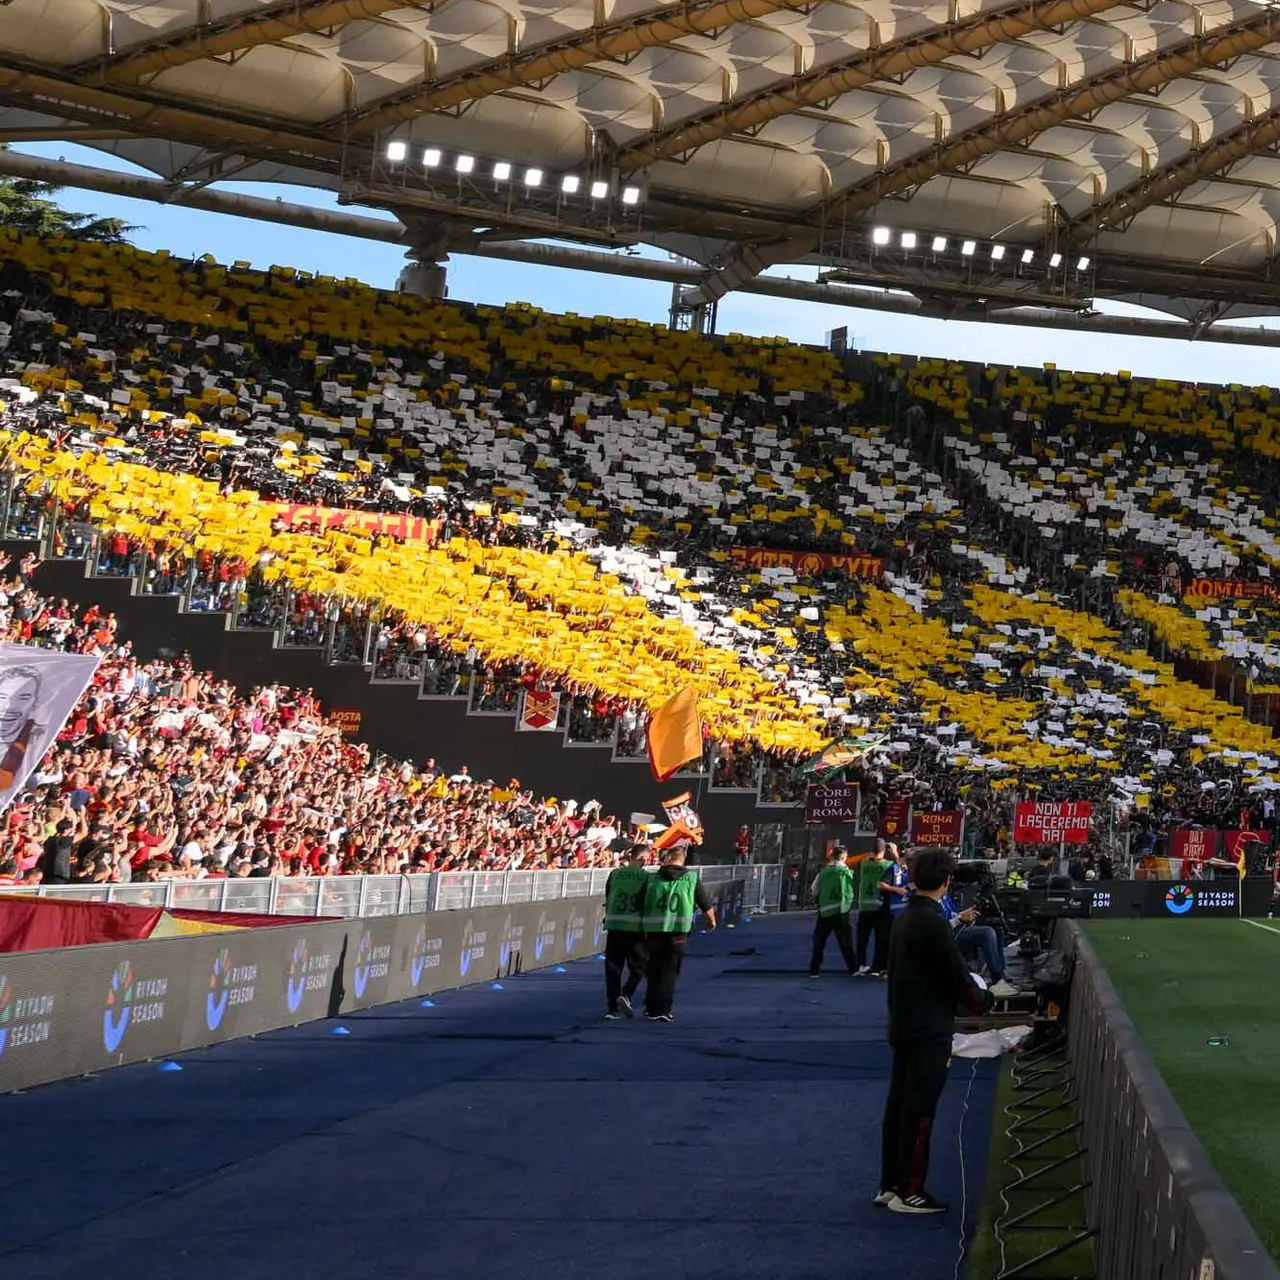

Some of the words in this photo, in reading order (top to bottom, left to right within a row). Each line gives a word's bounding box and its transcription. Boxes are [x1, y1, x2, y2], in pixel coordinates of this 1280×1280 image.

[814, 789, 852, 798] CORE
[824, 799, 842, 807] DE
[1035, 803, 1060, 816] NON
[1067, 803, 1077, 816] TI
[812, 808, 853, 817] ROMA
[922, 815, 953, 824] ROMA
[933, 825, 940, 833] O
[1019, 815, 1088, 830] LASCEREMO
[916, 834, 954, 843] MORTE
[1042, 829, 1066, 842] MAI
[657, 893, 680, 913] 40
[232, 965, 257, 983] RIYADH
[136, 978, 168, 999] RIYADH
[229, 986, 255, 1006] SEASON
[15, 995, 54, 1019] RIYADH
[131, 1002, 164, 1024] SEASON
[10, 1022, 50, 1047] SEASON
